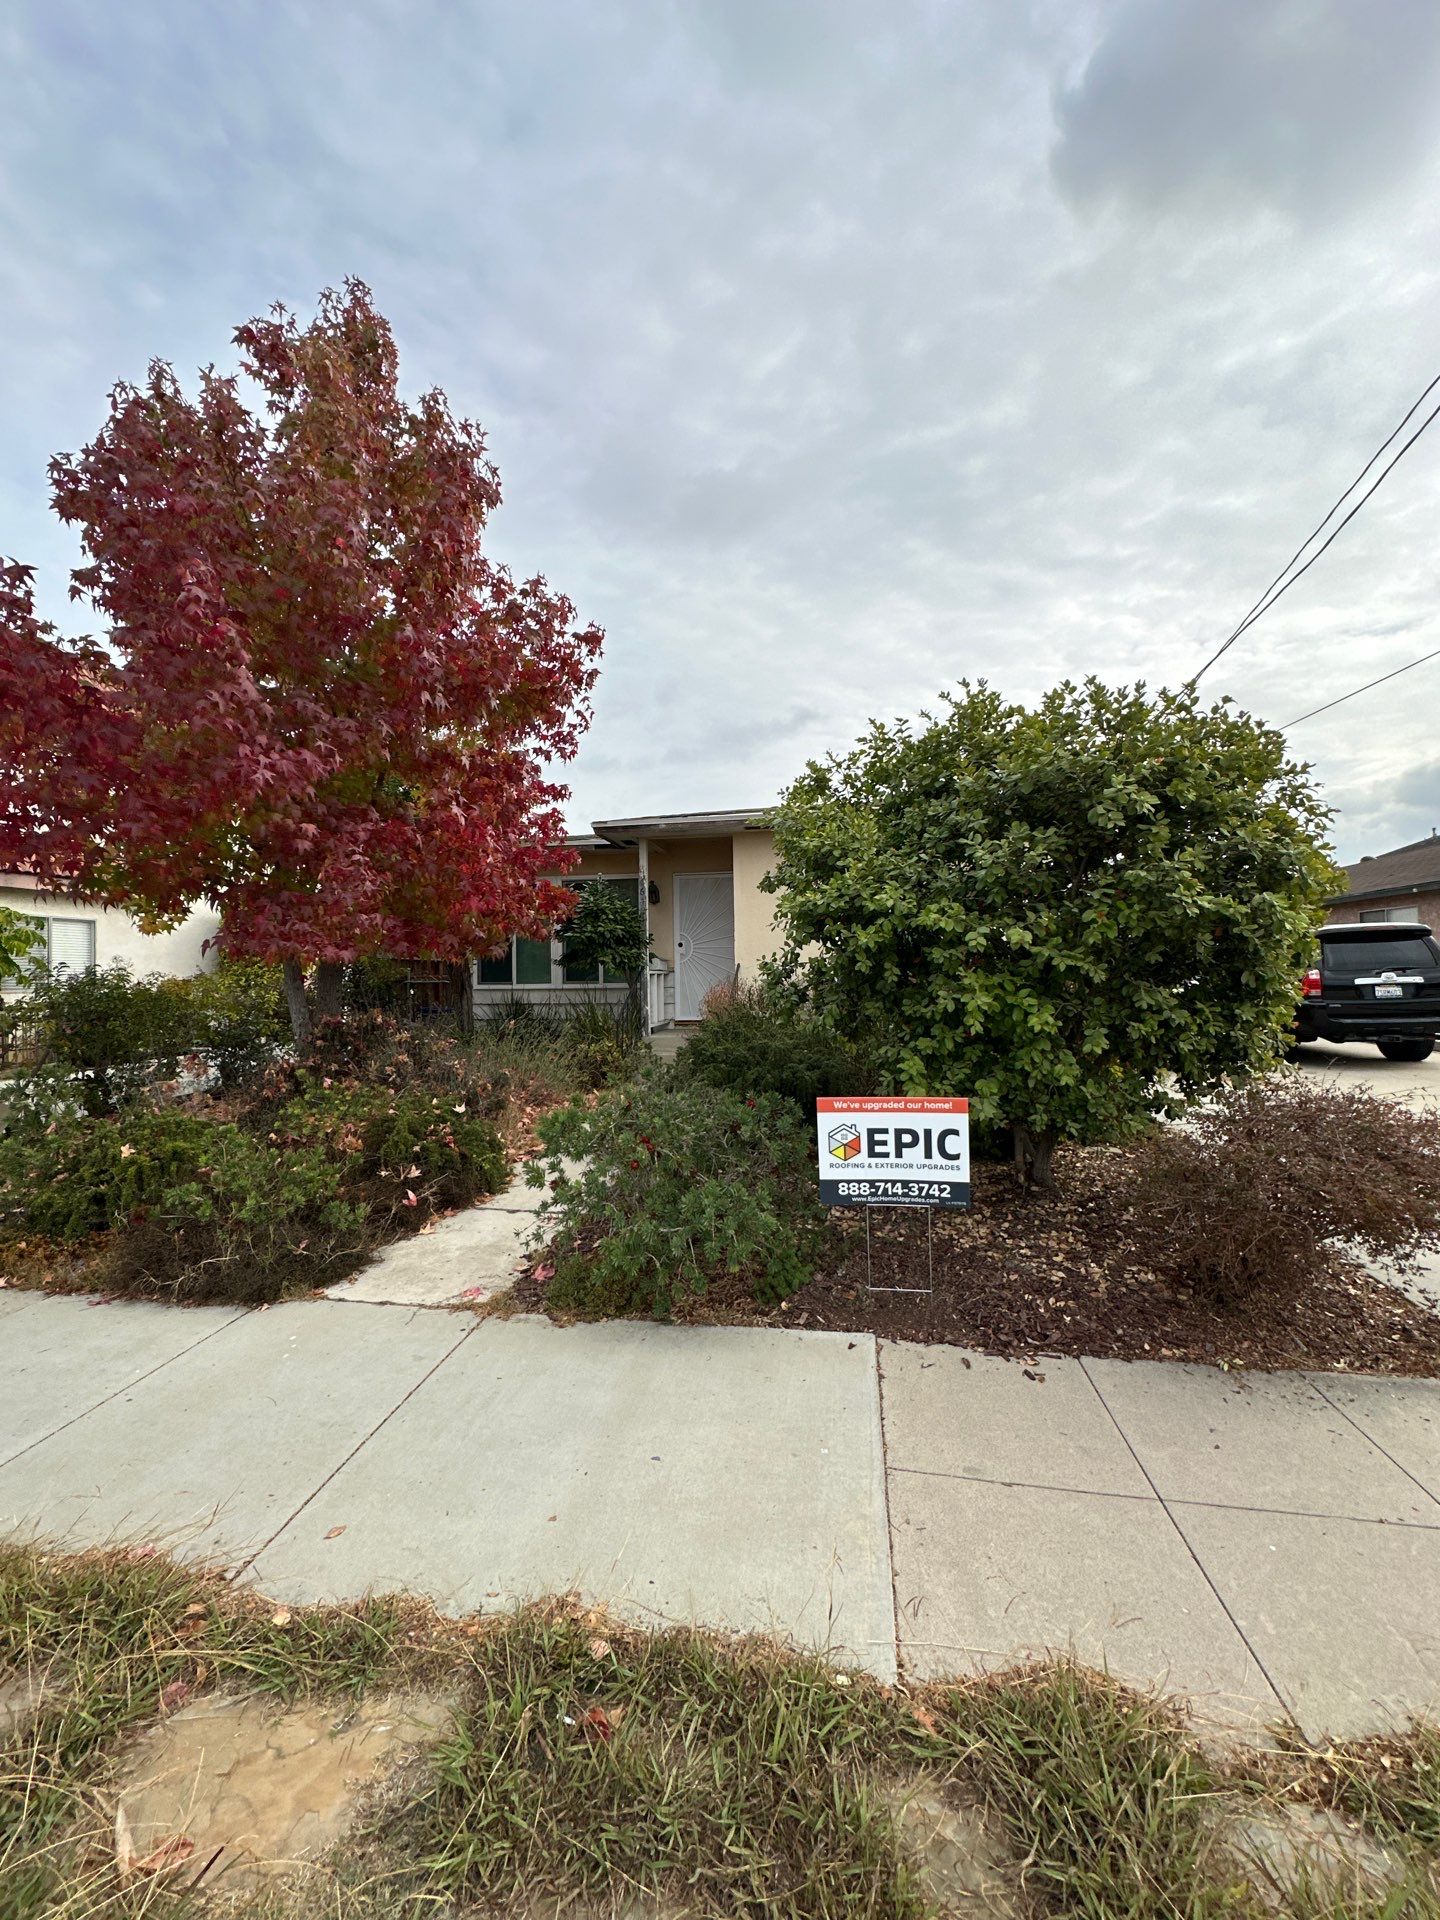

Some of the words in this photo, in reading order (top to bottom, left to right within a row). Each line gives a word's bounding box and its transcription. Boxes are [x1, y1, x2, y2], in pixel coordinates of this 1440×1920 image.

[833, 1101, 860, 1109] We've
[862, 1101, 905, 1110] upgraded
[924, 1101, 953, 1110] home!
[867, 1127, 961, 1161] EPIC
[875, 1162, 914, 1170] EXTERIOR
[916, 1163, 961, 1171] UPGRADES
[838, 1182, 951, 1198] 888-714-3742
[852, 1195, 940, 1204] www.EpicHomeUpgrades.com
